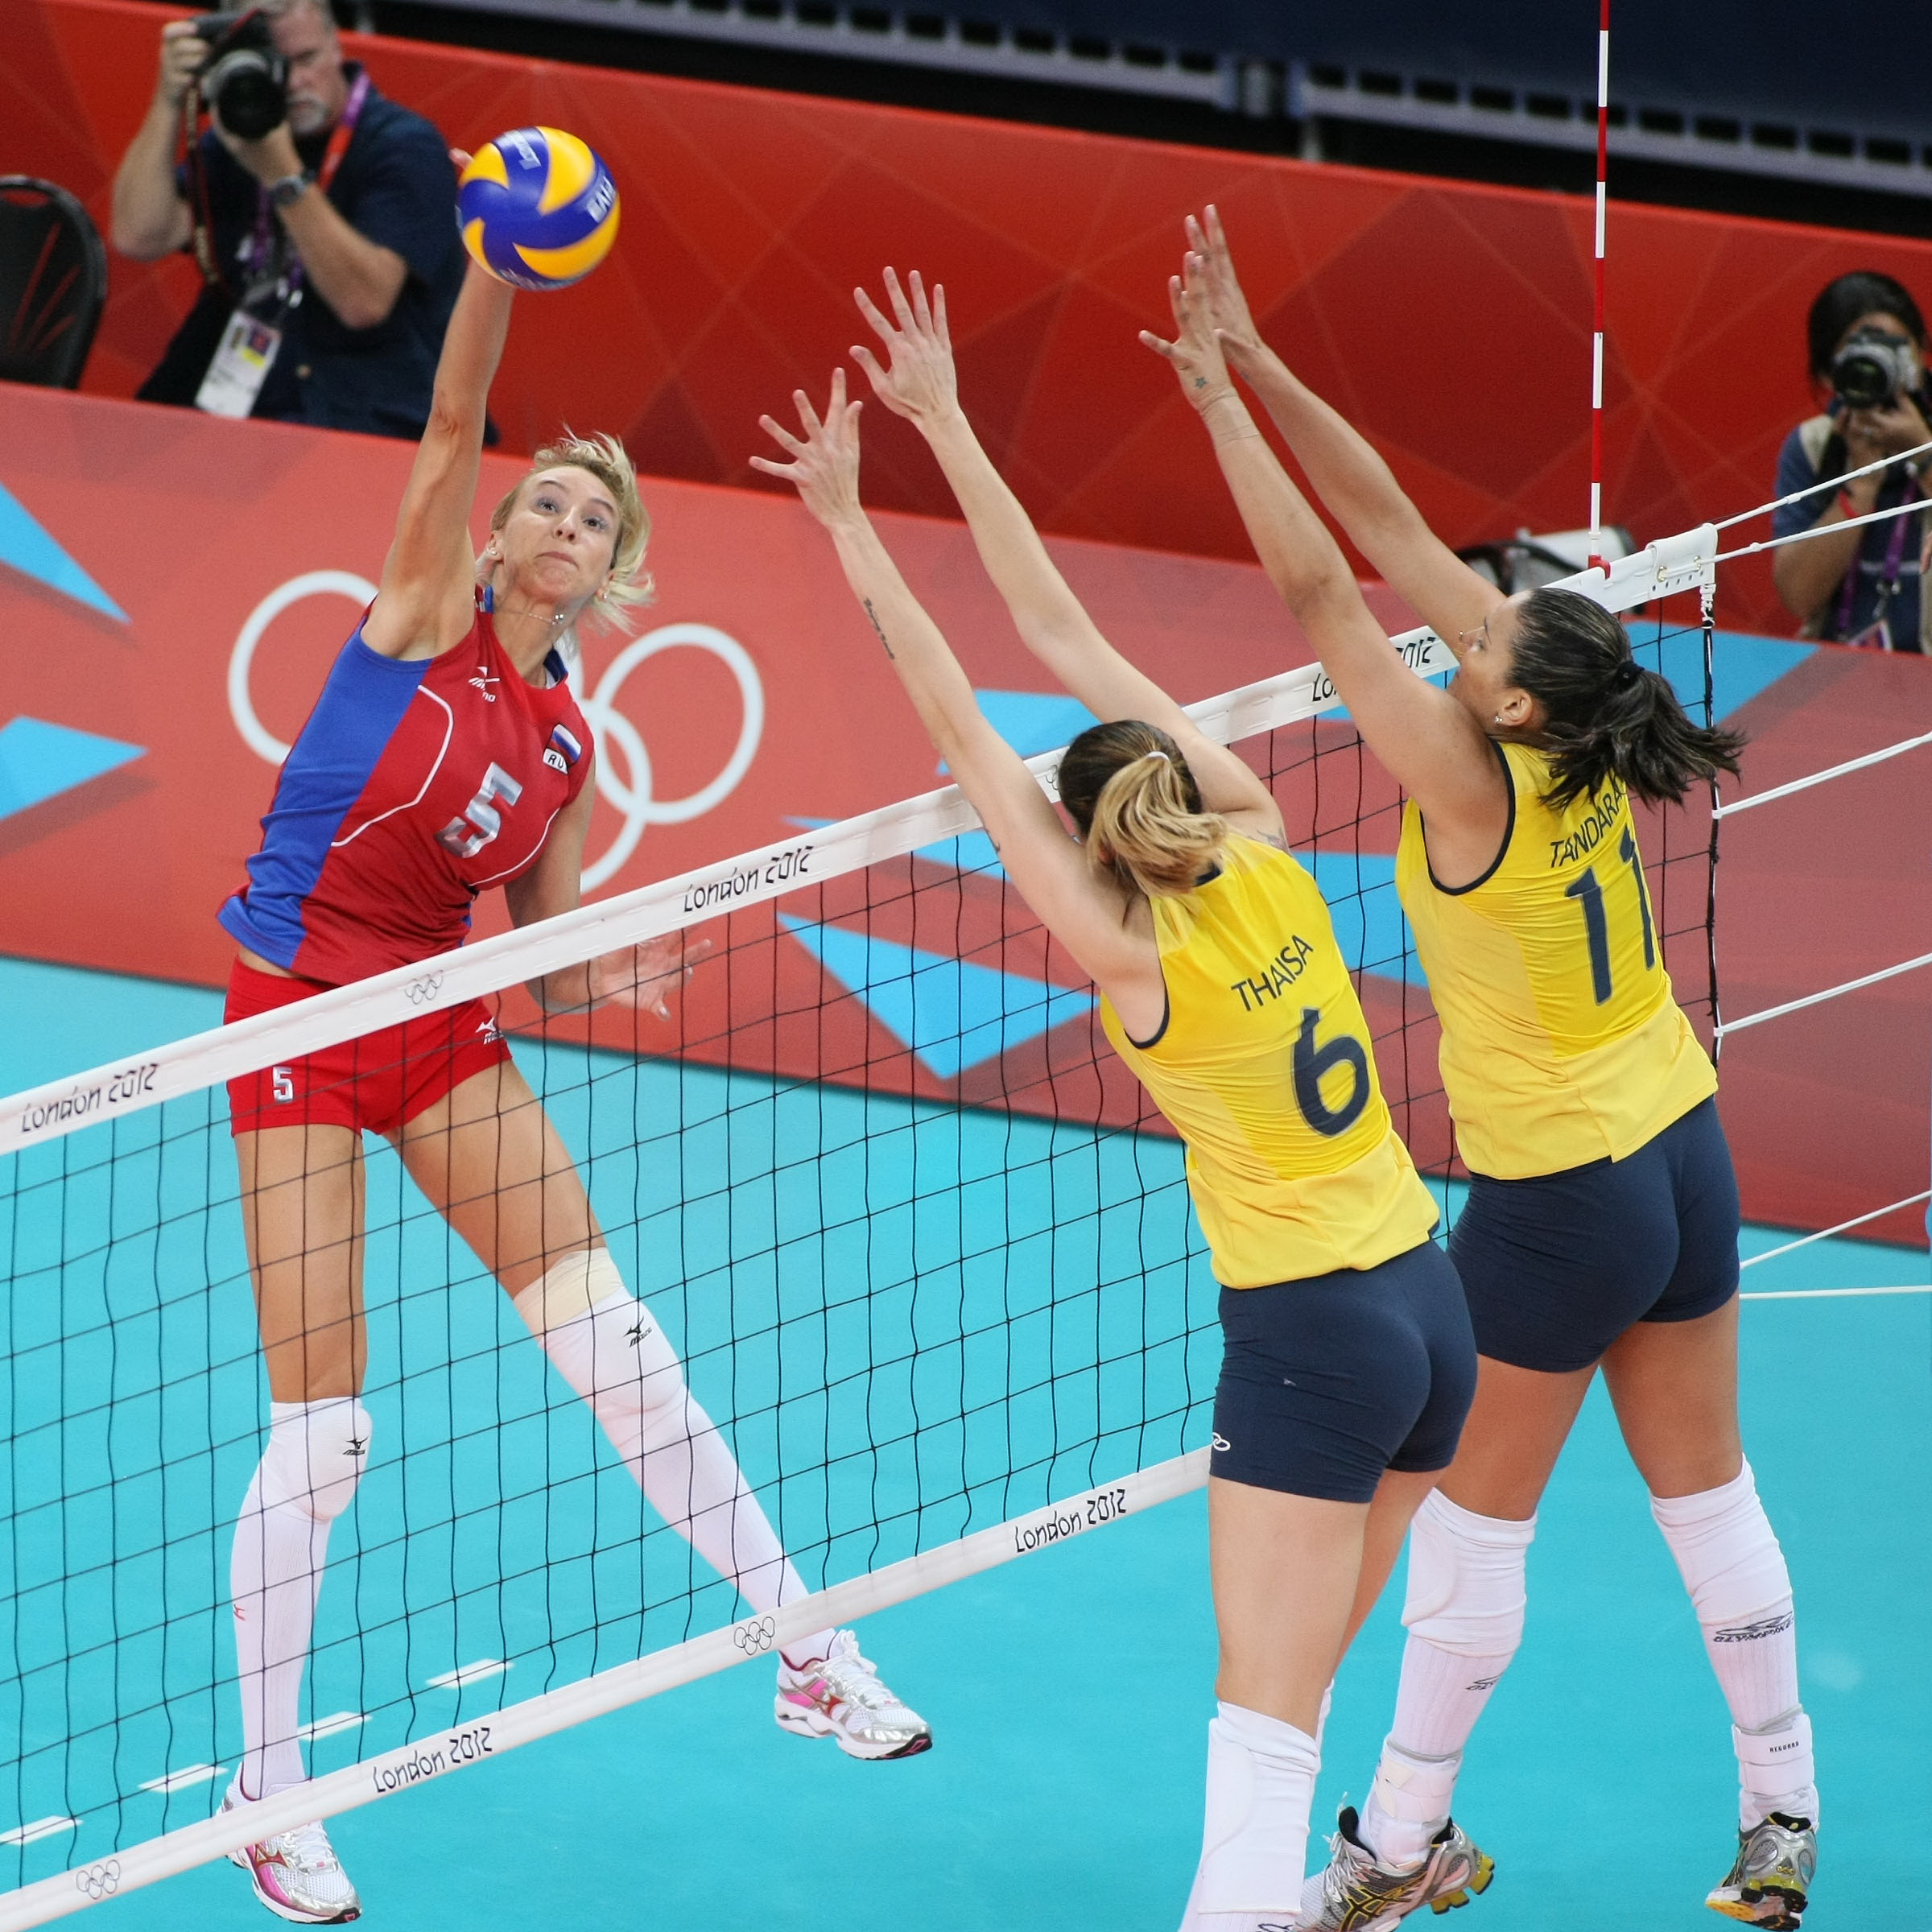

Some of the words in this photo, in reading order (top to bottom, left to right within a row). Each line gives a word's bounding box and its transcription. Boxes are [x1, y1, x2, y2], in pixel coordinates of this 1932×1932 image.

[1395, 637, 1436, 668] 012
[435, 762, 522, 858] 5
[684, 867, 759, 912] London
[766, 845, 813, 884] 2012
[1564, 823, 1655, 1005] 11
[1231, 935, 1314, 1011] THAISA
[22, 1086, 101, 1132] London
[109, 1063, 159, 1102] 2012
[273, 1066, 294, 1103] 5
[1291, 1006, 1372, 1138] 6
[1015, 1510, 1082, 1553] London
[1087, 1488, 1126, 1525] 2012
[373, 1750, 445, 1793] London
[449, 1728, 493, 1763] 2012
